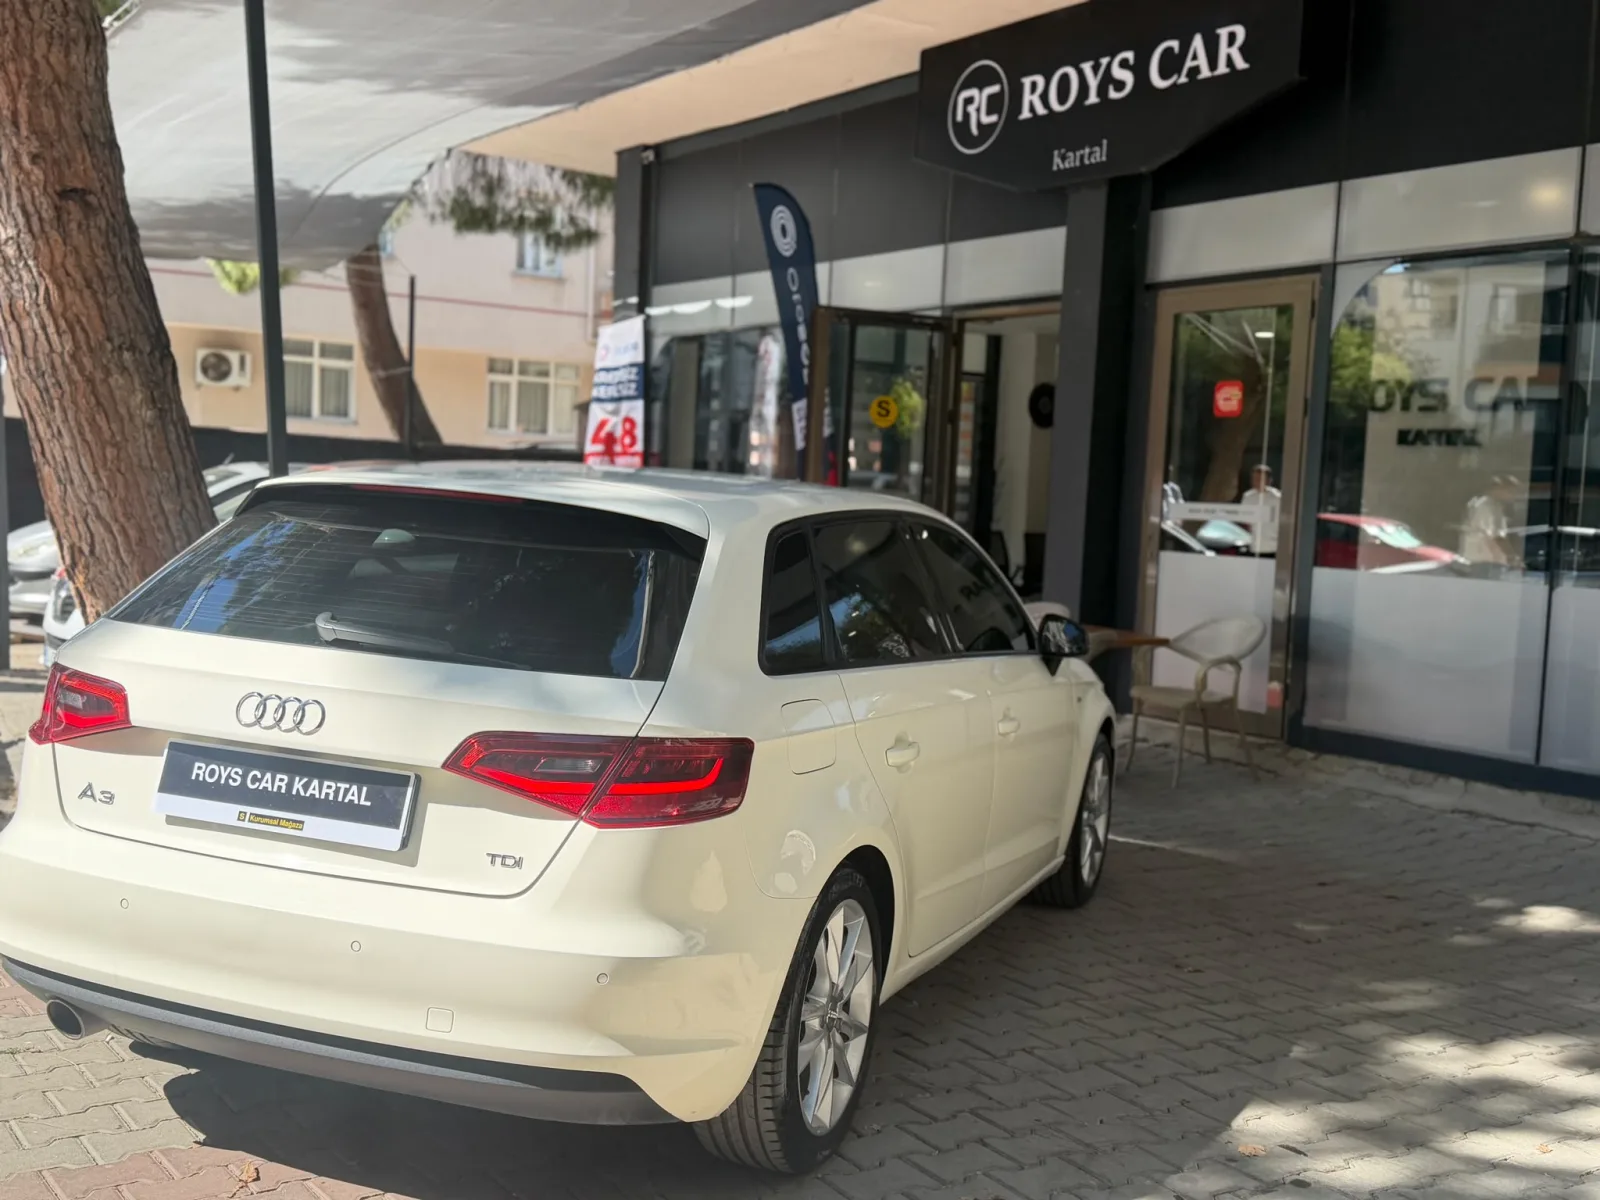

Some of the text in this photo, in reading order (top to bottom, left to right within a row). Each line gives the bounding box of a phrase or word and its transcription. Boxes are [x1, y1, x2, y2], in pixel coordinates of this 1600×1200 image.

[1018, 24, 1249, 120] ROYS CAR
[1052, 139, 1108, 171] Kartal
[876, 400, 890, 418] S
[591, 416, 638, 464] 48
[77, 781, 115, 805] A3
[191, 762, 372, 806] ROYS CAR KARTAL
[249, 814, 279, 826] Kurumsal
[279, 819, 303, 829] Mağaza
[486, 852, 524, 870] TDI
